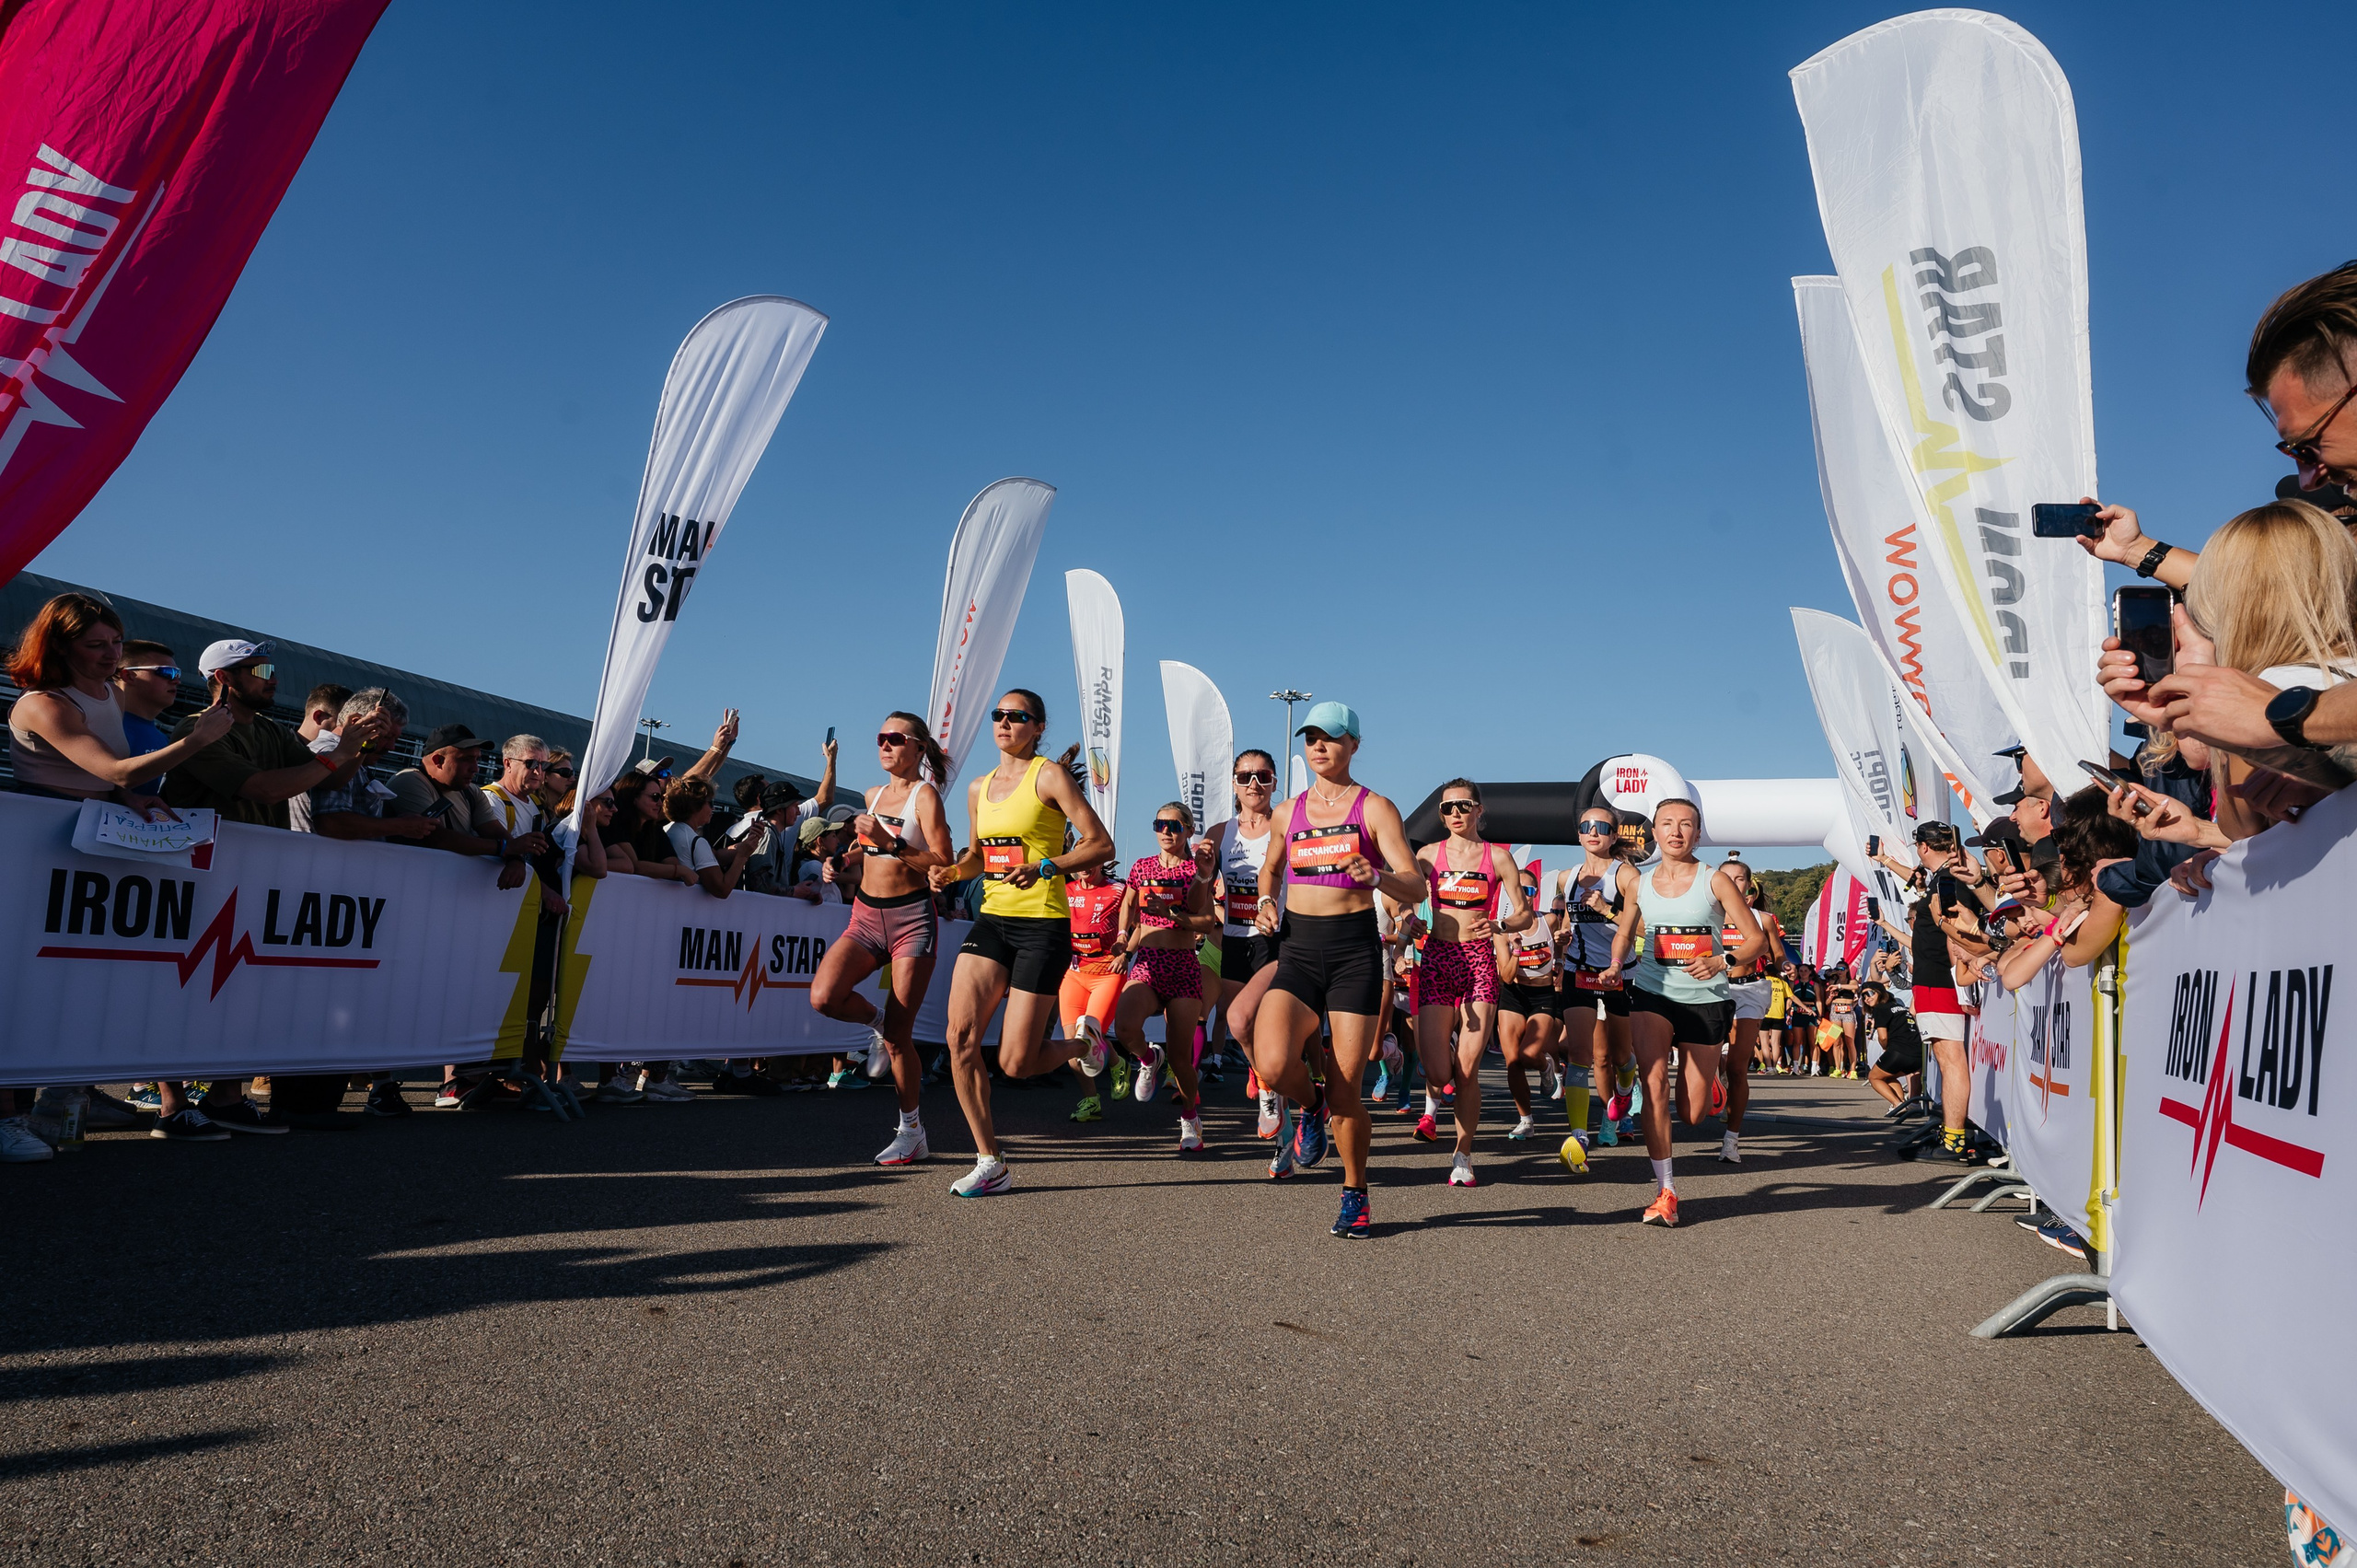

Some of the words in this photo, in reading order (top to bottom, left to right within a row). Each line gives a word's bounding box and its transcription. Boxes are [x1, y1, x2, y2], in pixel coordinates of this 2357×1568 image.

[0, 143, 137, 324] LADY
[1616, 768, 1639, 778] IRON
[1616, 779, 1648, 793] LADY
[1297, 843, 1351, 857] ПЕСЧАНСКАЯ
[44, 868, 196, 941] IRON
[262, 889, 387, 949] LADY
[1232, 901, 1258, 911] ПИХТОРО
[679, 926, 743, 972] MAN
[770, 935, 826, 975] STAR
[2051, 1001, 2071, 1070] STAR
[2165, 968, 2219, 1086] IRON
[2238, 964, 2334, 1117] LADY
